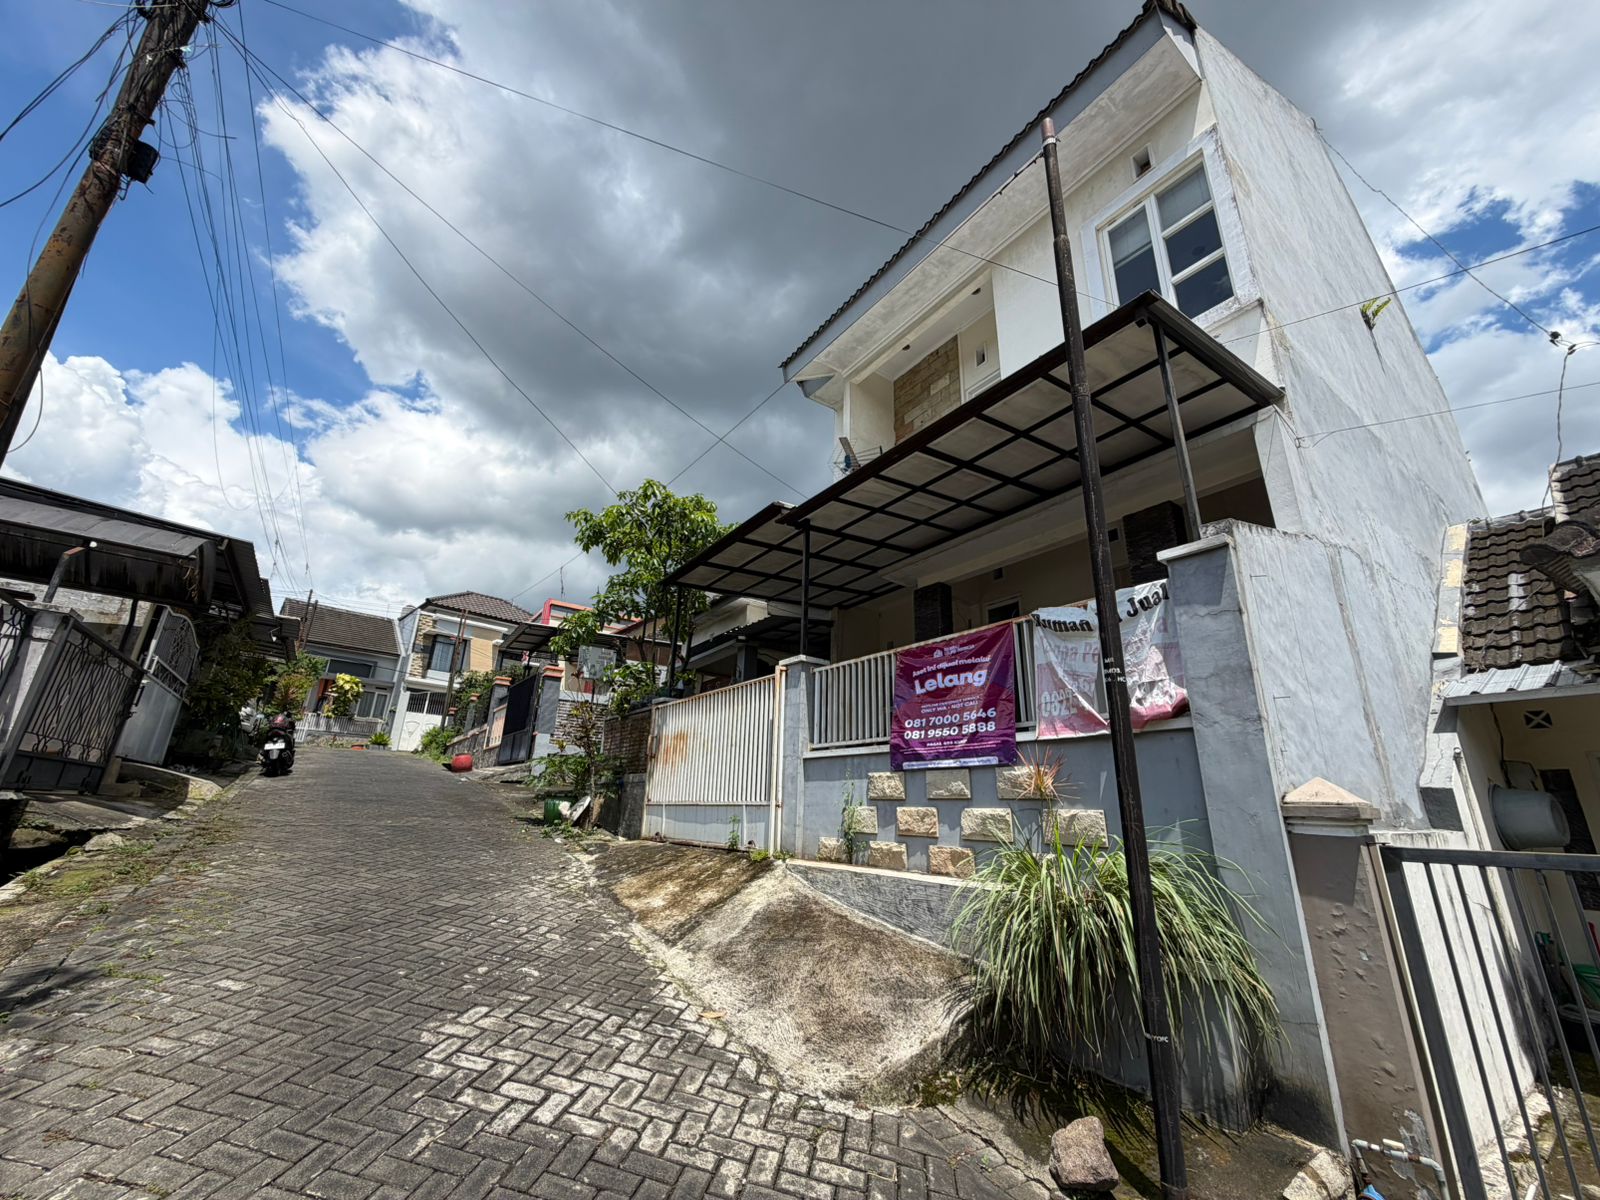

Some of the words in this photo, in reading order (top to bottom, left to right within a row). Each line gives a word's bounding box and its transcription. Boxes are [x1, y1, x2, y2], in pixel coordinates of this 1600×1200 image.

[1127, 583, 1169, 617] Jual
[914, 669, 988, 695] Lelang
[904, 718, 926, 728] 081
[929, 713, 960, 726] 7000
[963, 707, 997, 721] 5646
[904, 730, 925, 740] 081
[927, 726, 959, 738] 9550
[961, 721, 996, 735] 5888
